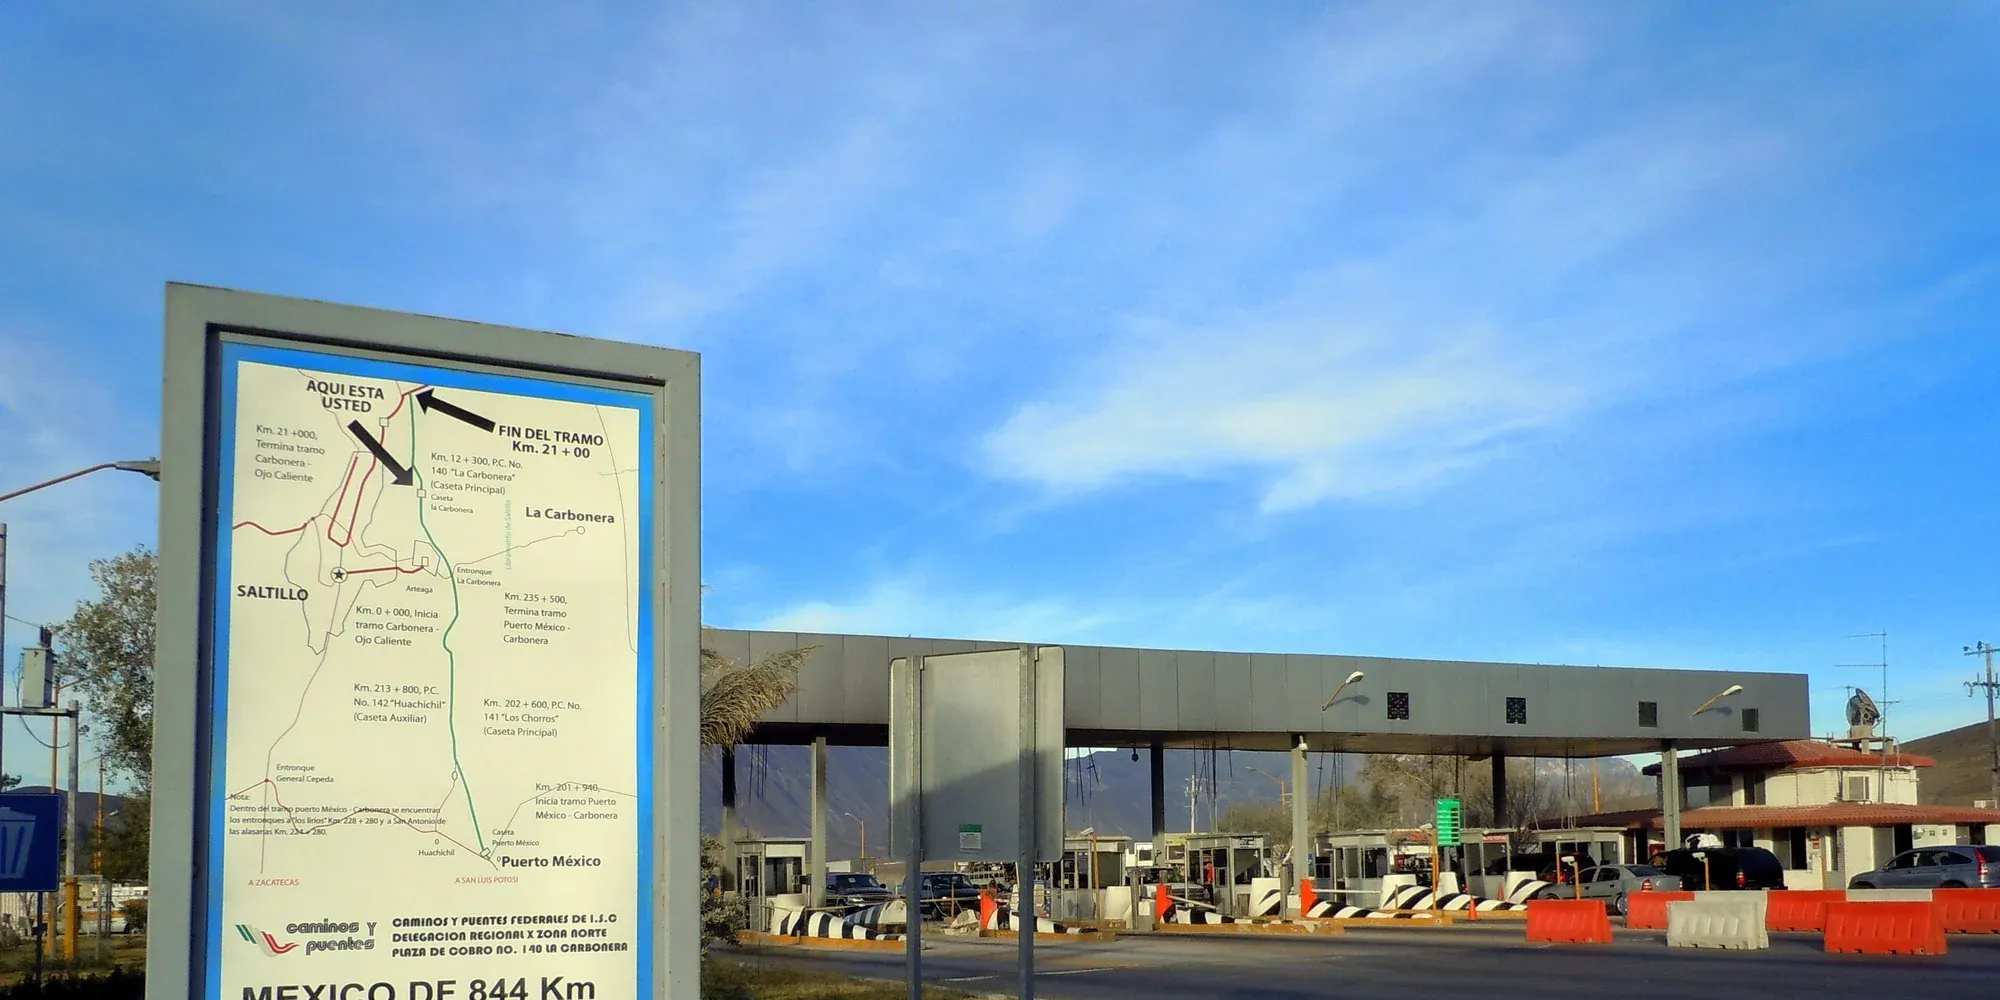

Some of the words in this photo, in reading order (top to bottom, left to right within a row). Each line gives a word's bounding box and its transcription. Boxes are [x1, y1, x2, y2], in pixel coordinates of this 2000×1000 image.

[306, 380, 345, 396] AQUI
[349, 385, 385, 400] ESTA
[322, 397, 372, 413] USTED
[256, 425, 275, 435] Km.
[278, 428, 288, 436] 21
[499, 425, 521, 438] FIN
[525, 428, 551, 441] DEL
[554, 431, 604, 446] TRAMO
[256, 440, 294, 452] Termina
[296, 445, 325, 455] tramo
[512, 441, 539, 454] Km.
[542, 444, 557, 456] 21
[574, 447, 590, 458] 00
[256, 454, 305, 468] Carbonera
[431, 452, 448, 462] Km.
[450, 454, 461, 463] 12
[472, 456, 490, 467] 300,
[492, 458, 507, 467] P.C.
[509, 460, 523, 469] No.
[255, 469, 272, 480] Ojo
[275, 472, 313, 483] Caliente
[431, 466, 448, 476] 140
[430, 480, 463, 492] (Caseta
[465, 484, 506, 496] Principal)
[431, 494, 453, 502] Caseta
[438, 505, 473, 514] Carbonera
[526, 506, 541, 518] La
[545, 509, 615, 523] Carbonera
[457, 567, 493, 576] Entronque
[466, 578, 501, 587] Carbonera
[238, 585, 309, 601] SALTILLO
[406, 585, 433, 594] Arteaga
[505, 592, 521, 601] Km.
[524, 594, 539, 602] 235
[550, 595, 567, 605] 500,
[356, 606, 373, 615] Km.
[393, 608, 412, 619] 000,
[414, 609, 438, 619] Inicia
[504, 606, 539, 616] Termina
[542, 609, 567, 618] tramo
[356, 622, 383, 630] tramo
[386, 622, 434, 633] Carbonera
[504, 620, 533, 630] Puerto
[535, 622, 566, 632] México
[355, 635, 372, 646] Ojo
[374, 637, 412, 647] Caliente
[503, 635, 549, 645] Carbonera
[354, 683, 372, 693] Km.
[374, 684, 391, 693] 213
[402, 685, 422, 695] 800,
[424, 686, 438, 695] P.C.
[354, 698, 370, 707] No.
[372, 699, 389, 708] 142
[484, 699, 501, 708] Km.
[505, 700, 521, 708] 202
[531, 701, 550, 711] 600,
[551, 702, 566, 710] P.C.
[568, 702, 582, 710] No.
[354, 713, 388, 723] (Caseta
[390, 713, 427, 724] Auxiliar)
[484, 713, 500, 722] 141
[502, 713, 520, 722] "Los
[522, 714, 559, 723] Chorros"
[483, 727, 515, 737] (Caseta
[517, 728, 558, 738] Principal)
[277, 764, 315, 773] Entronque
[276, 775, 305, 783] General
[307, 776, 334, 784] Cepeda
[535, 783, 551, 791] Km.
[535, 797, 558, 806] Inicia
[588, 798, 616, 806] Puerto
[295, 806, 320, 814] puerto
[353, 806, 390, 814] Carbonera
[535, 810, 566, 820] México
[574, 811, 618, 820] Carbonera
[230, 816, 240, 824] los
[242, 817, 286, 825] entronques
[516, 839, 539, 847] México
[419, 849, 455, 857] Huachichil
[1254, 850, 1259, 858] 4
[502, 856, 549, 868] Puerto
[553, 855, 601, 867] México
[255, 879, 300, 887] ZACATECAS
[392, 917, 448, 927] CAMINOS
[451, 917, 459, 926] Y
[461, 916, 508, 926] PUENTES
[510, 915, 569, 925] FEDERALES
[572, 914, 587, 923] DE
[590, 914, 618, 923] I.S.C
[286, 918, 360, 934] caminos
[367, 922, 377, 936] Y
[392, 932, 466, 942] DELEGACION
[470, 931, 525, 941] REGIONAL
[527, 930, 534, 939] X
[536, 929, 567, 939] ZONA
[571, 929, 607, 938] NORTE
[306, 937, 375, 956] puentes
[392, 948, 426, 958] PLAZA
[430, 947, 446, 956] DE
[449, 946, 493, 956] COBRO
[496, 945, 517, 955] NO.
[523, 944, 543, 954] 140
[546, 944, 557, 953] LA
[560, 942, 628, 952] CARBONERA
[242, 982, 396, 1000] MEXICO
[410, 980, 456, 1000] DE
[469, 978, 529, 1000] 844
[541, 976, 595, 1000] Km
